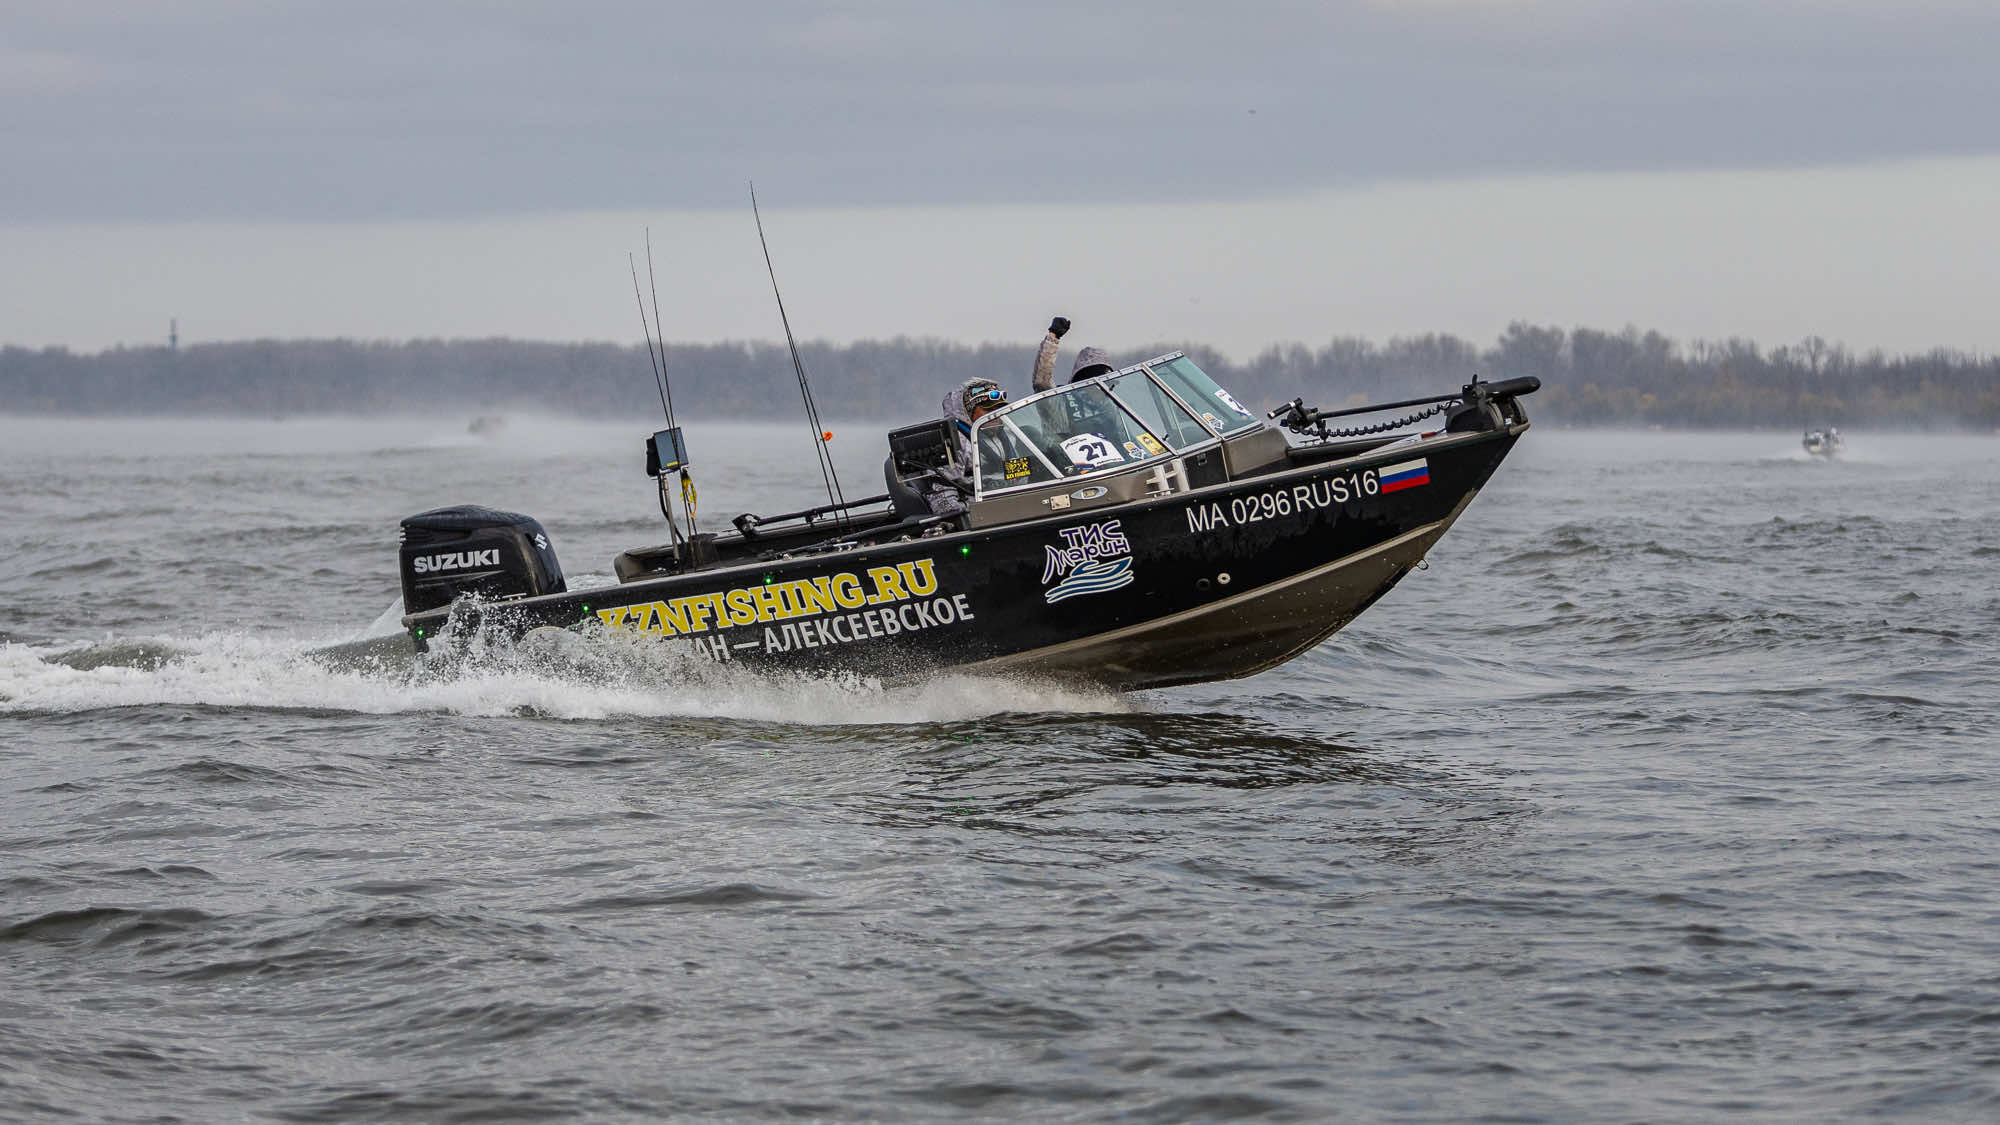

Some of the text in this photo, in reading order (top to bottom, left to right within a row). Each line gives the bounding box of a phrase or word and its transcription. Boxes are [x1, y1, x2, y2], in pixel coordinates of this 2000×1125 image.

[1079, 442, 1107, 461] 27
[1186, 503, 1229, 533] MA
[1232, 490, 1291, 524] 0296
[1059, 519, 1124, 548] ТИС
[413, 549, 501, 573] SUZUKI
[596, 558, 939, 638] KZNFISHING.RU
